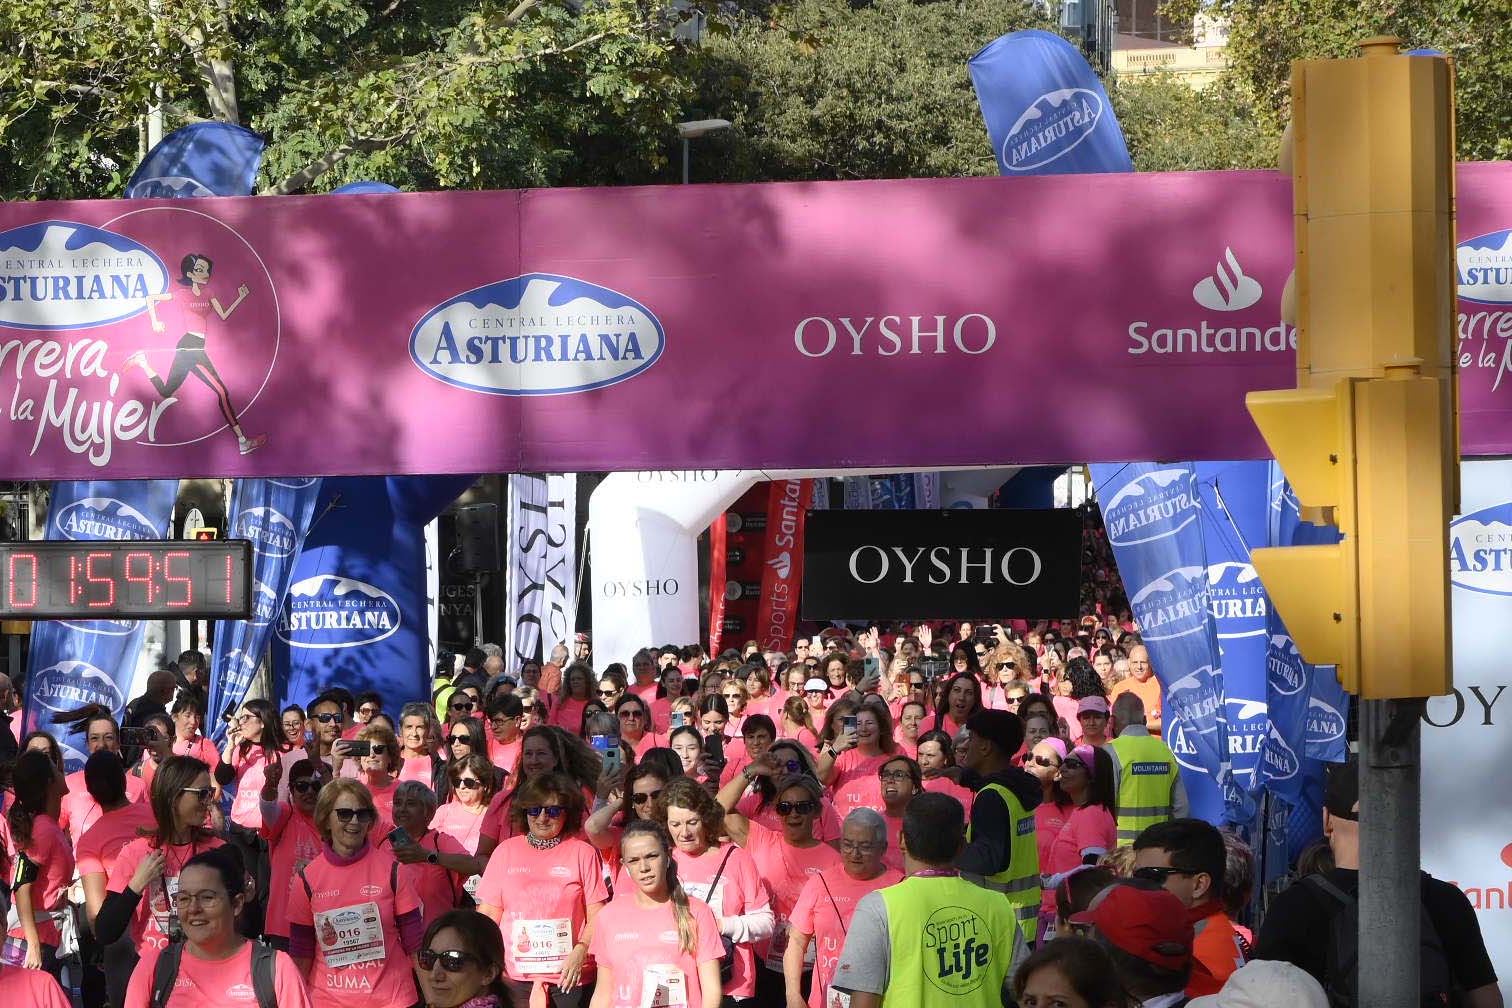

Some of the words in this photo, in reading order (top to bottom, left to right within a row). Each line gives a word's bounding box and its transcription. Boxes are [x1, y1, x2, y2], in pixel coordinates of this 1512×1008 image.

[72, 257, 144, 269] LECHERA
[468, 315, 547, 329] CENTRAL
[556, 313, 636, 327] LECHERA
[430, 321, 644, 365] ASTURIANA
[794, 313, 997, 358] OYSHO
[1478, 342, 1496, 368] la
[10, 381, 34, 422] la
[30, 373, 180, 467] Mujer
[849, 545, 1042, 586] OYSHO
[603, 579, 680, 598] OYSHO
[291, 600, 334, 609] CENTRAL
[278, 610, 392, 633] ASTURIANA
[847, 793, 861, 803] TU
[339, 928, 361, 939] 016
[926, 915, 978, 949] Sport
[937, 938, 989, 980] Life
[327, 974, 371, 989] SUMA
